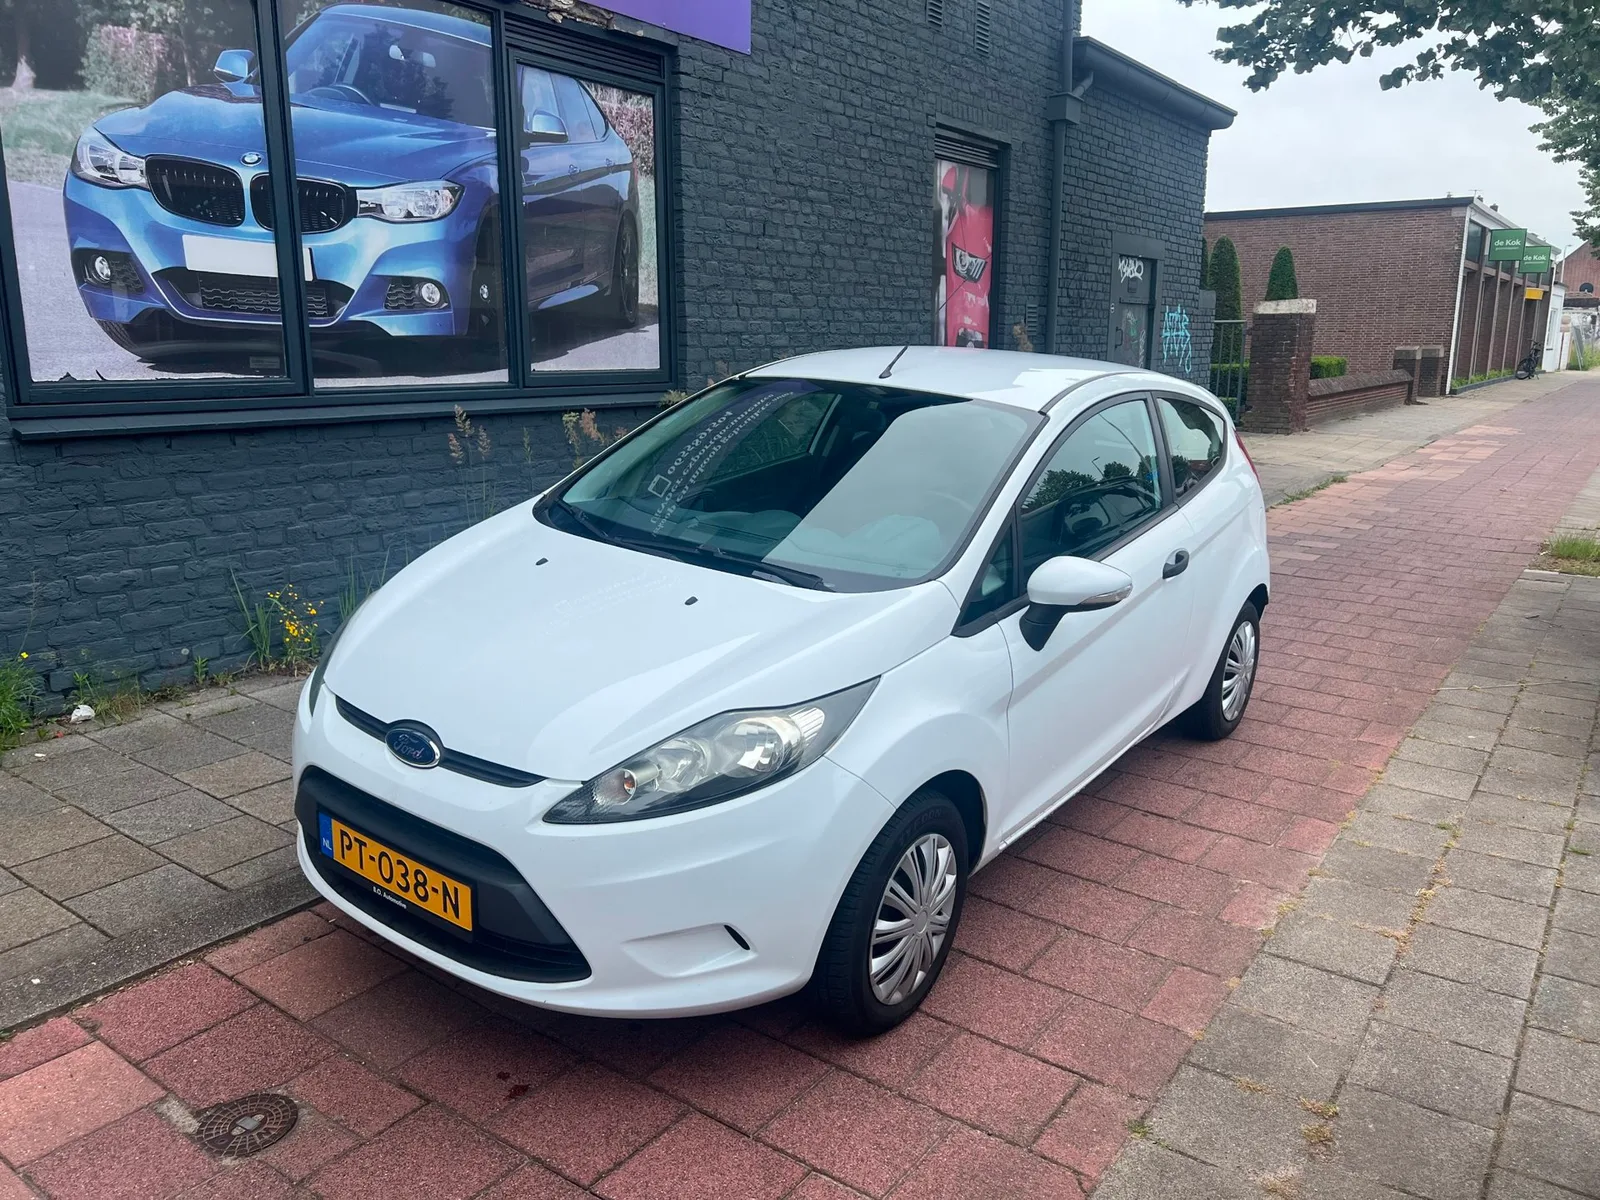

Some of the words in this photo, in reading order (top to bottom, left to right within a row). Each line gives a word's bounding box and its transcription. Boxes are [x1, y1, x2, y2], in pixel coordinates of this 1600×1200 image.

[1505, 238, 1521, 246] Kok
[393, 733, 425, 760] Ford
[322, 837, 333, 851] NL
[339, 828, 461, 920] PT-038-N
